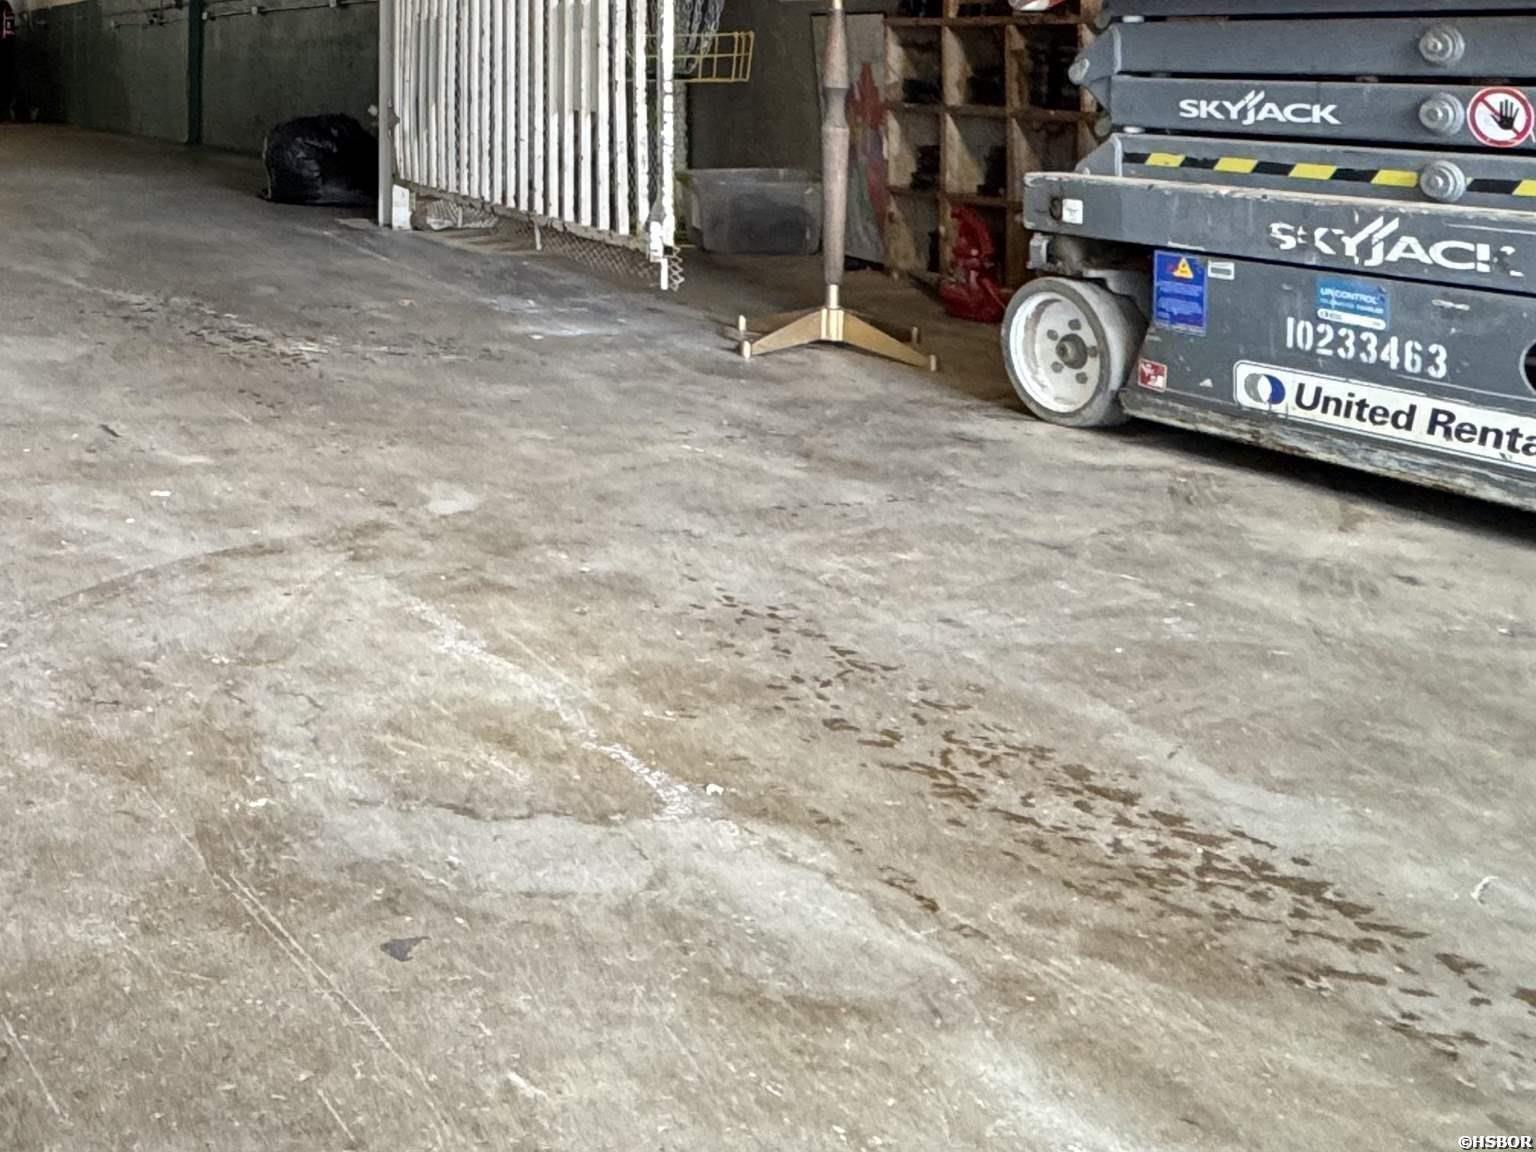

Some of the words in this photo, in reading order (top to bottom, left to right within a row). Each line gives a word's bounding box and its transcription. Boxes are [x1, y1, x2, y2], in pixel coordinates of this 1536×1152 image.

[1179, 90, 1343, 125] SKYJACK
[1286, 317, 1448, 379] 10233463
[1294, 383, 1417, 432] United
